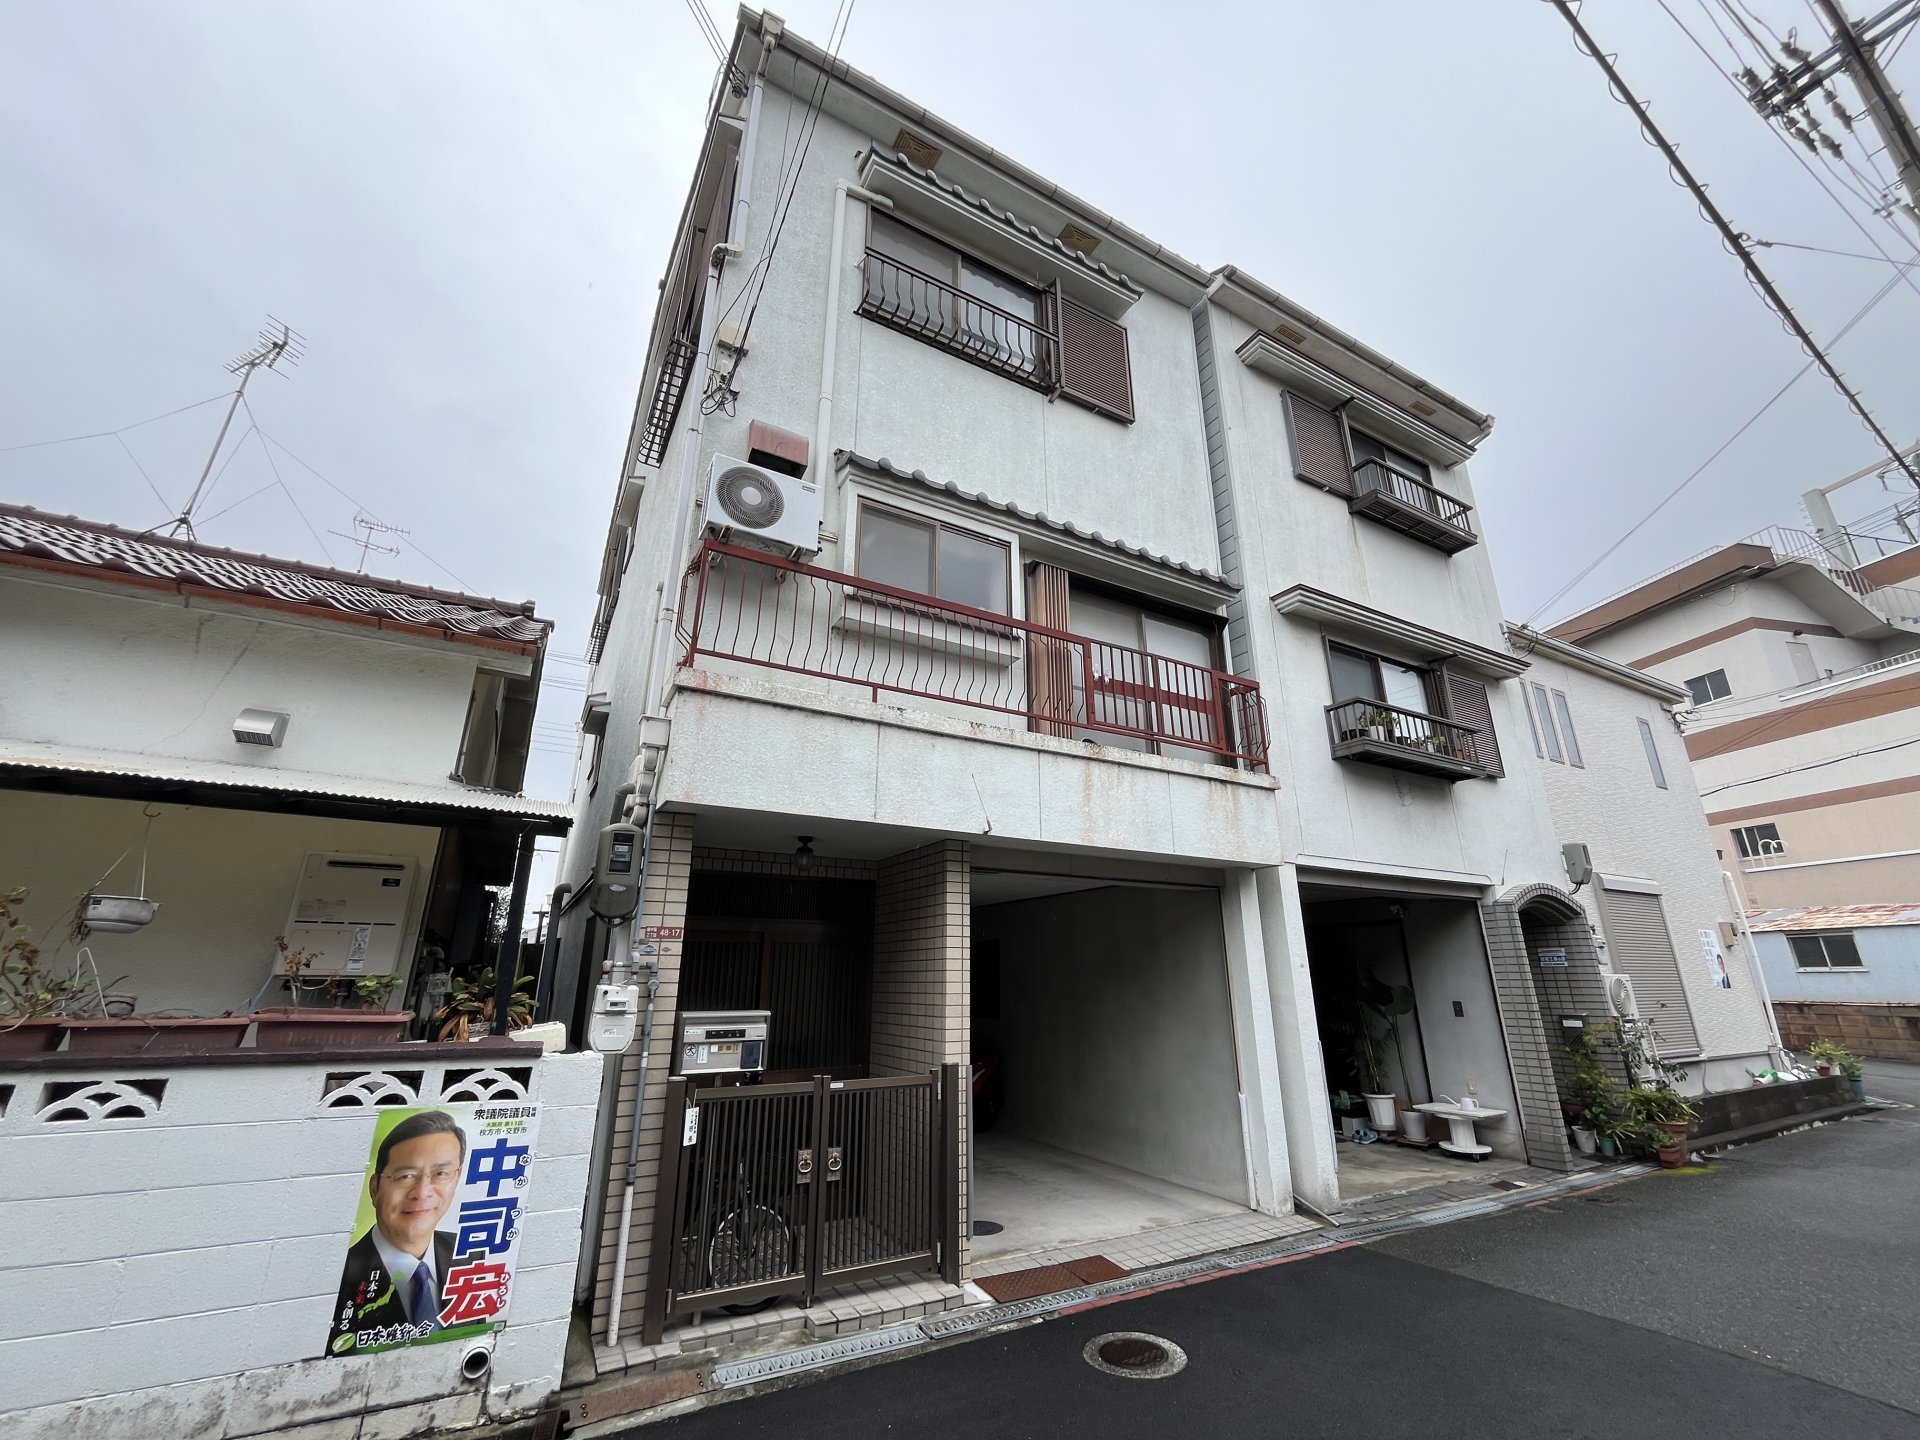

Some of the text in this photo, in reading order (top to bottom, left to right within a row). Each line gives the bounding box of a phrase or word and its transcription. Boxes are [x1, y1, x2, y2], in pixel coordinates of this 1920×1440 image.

[439, 1138, 530, 1325] 中司 宏
[367, 1270, 380, 1298] 日本の
[497, 1272, 510, 1308] ひろし
